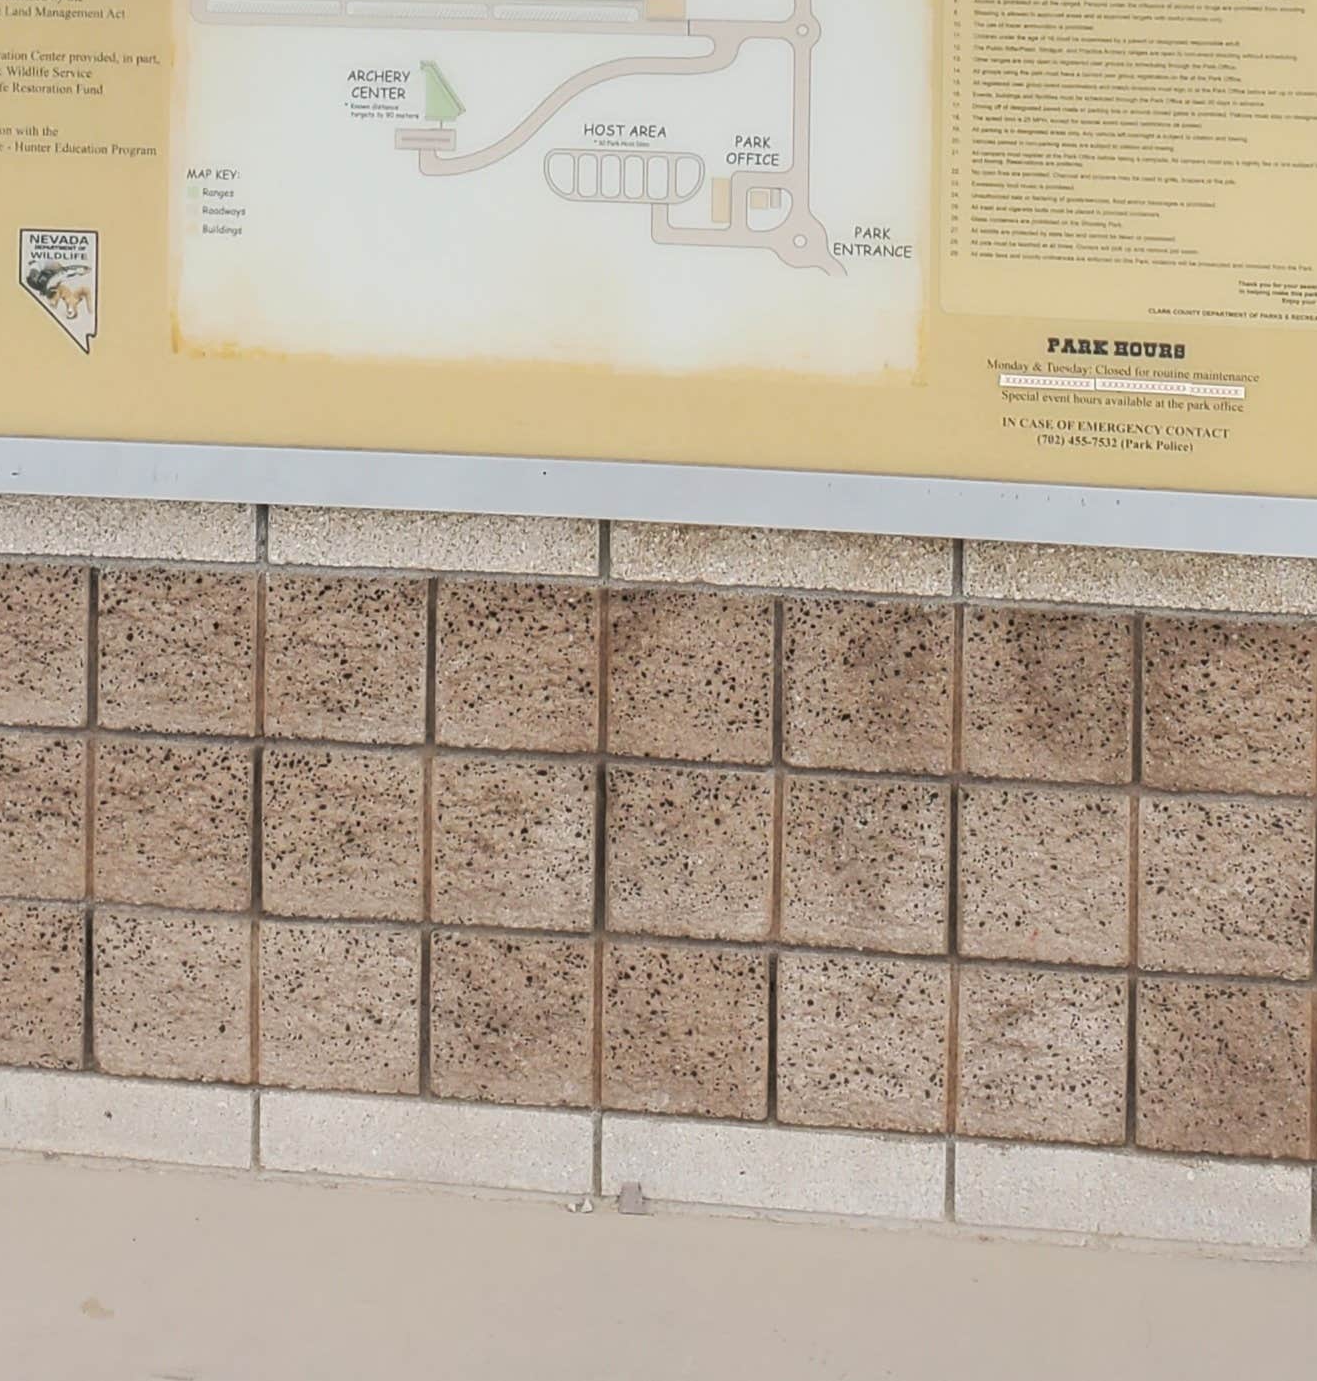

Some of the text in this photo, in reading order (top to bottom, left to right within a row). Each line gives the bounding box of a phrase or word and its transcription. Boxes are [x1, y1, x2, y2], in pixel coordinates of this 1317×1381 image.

[347, 70, 411, 84] ARCHERY
[351, 86, 406, 100] CENTER
[584, 124, 667, 139] HOST AREA
[734, 135, 771, 150] PARK
[726, 151, 780, 166] OFFICE
[187, 169, 240, 180] MAP KEY:
[202, 188, 234, 199] Ranges
[202, 206, 246, 216] Roadways
[202, 225, 243, 236] Buildings
[854, 227, 890, 240] PARK
[29, 234, 90, 245] NEVADA
[30, 251, 88, 261] WILDLIFE
[832, 243, 912, 259] ENTRANCE
[1047, 338, 1186, 359] PARK HOURS
